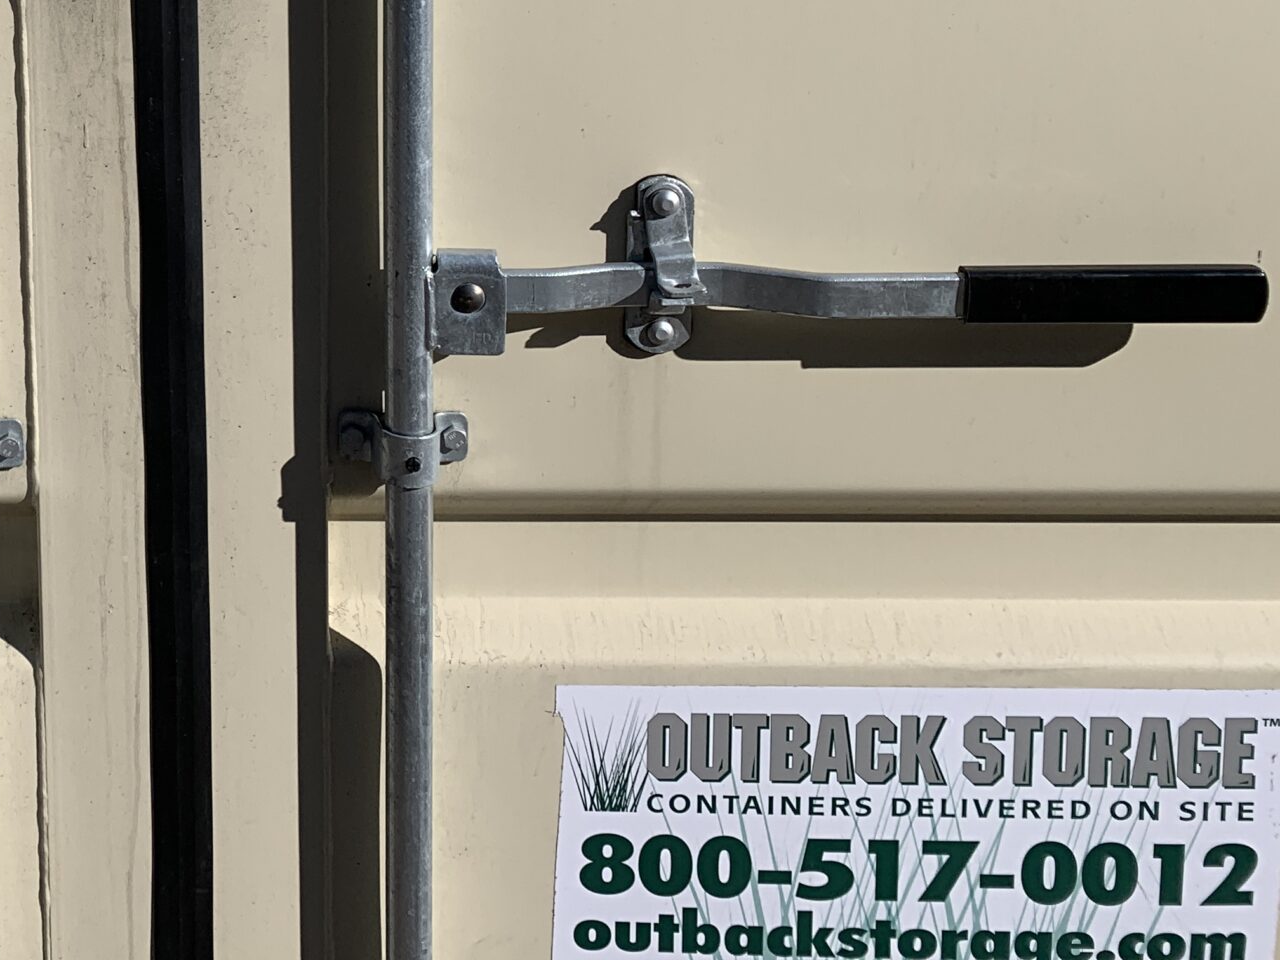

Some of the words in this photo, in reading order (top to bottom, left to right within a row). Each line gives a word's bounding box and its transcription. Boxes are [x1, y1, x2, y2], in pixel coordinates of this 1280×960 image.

[646, 711, 948, 786] OUTBACK
[962, 715, 1259, 789] STORAGE
[646, 793, 873, 817] CONTAINERS
[891, 797, 1091, 820] DELIVERED
[1110, 799, 1160, 822] ON
[1179, 801, 1255, 822] SITE
[579, 832, 1259, 906] 800-517-0012
[573, 907, 1248, 960] outbackstorage.com
